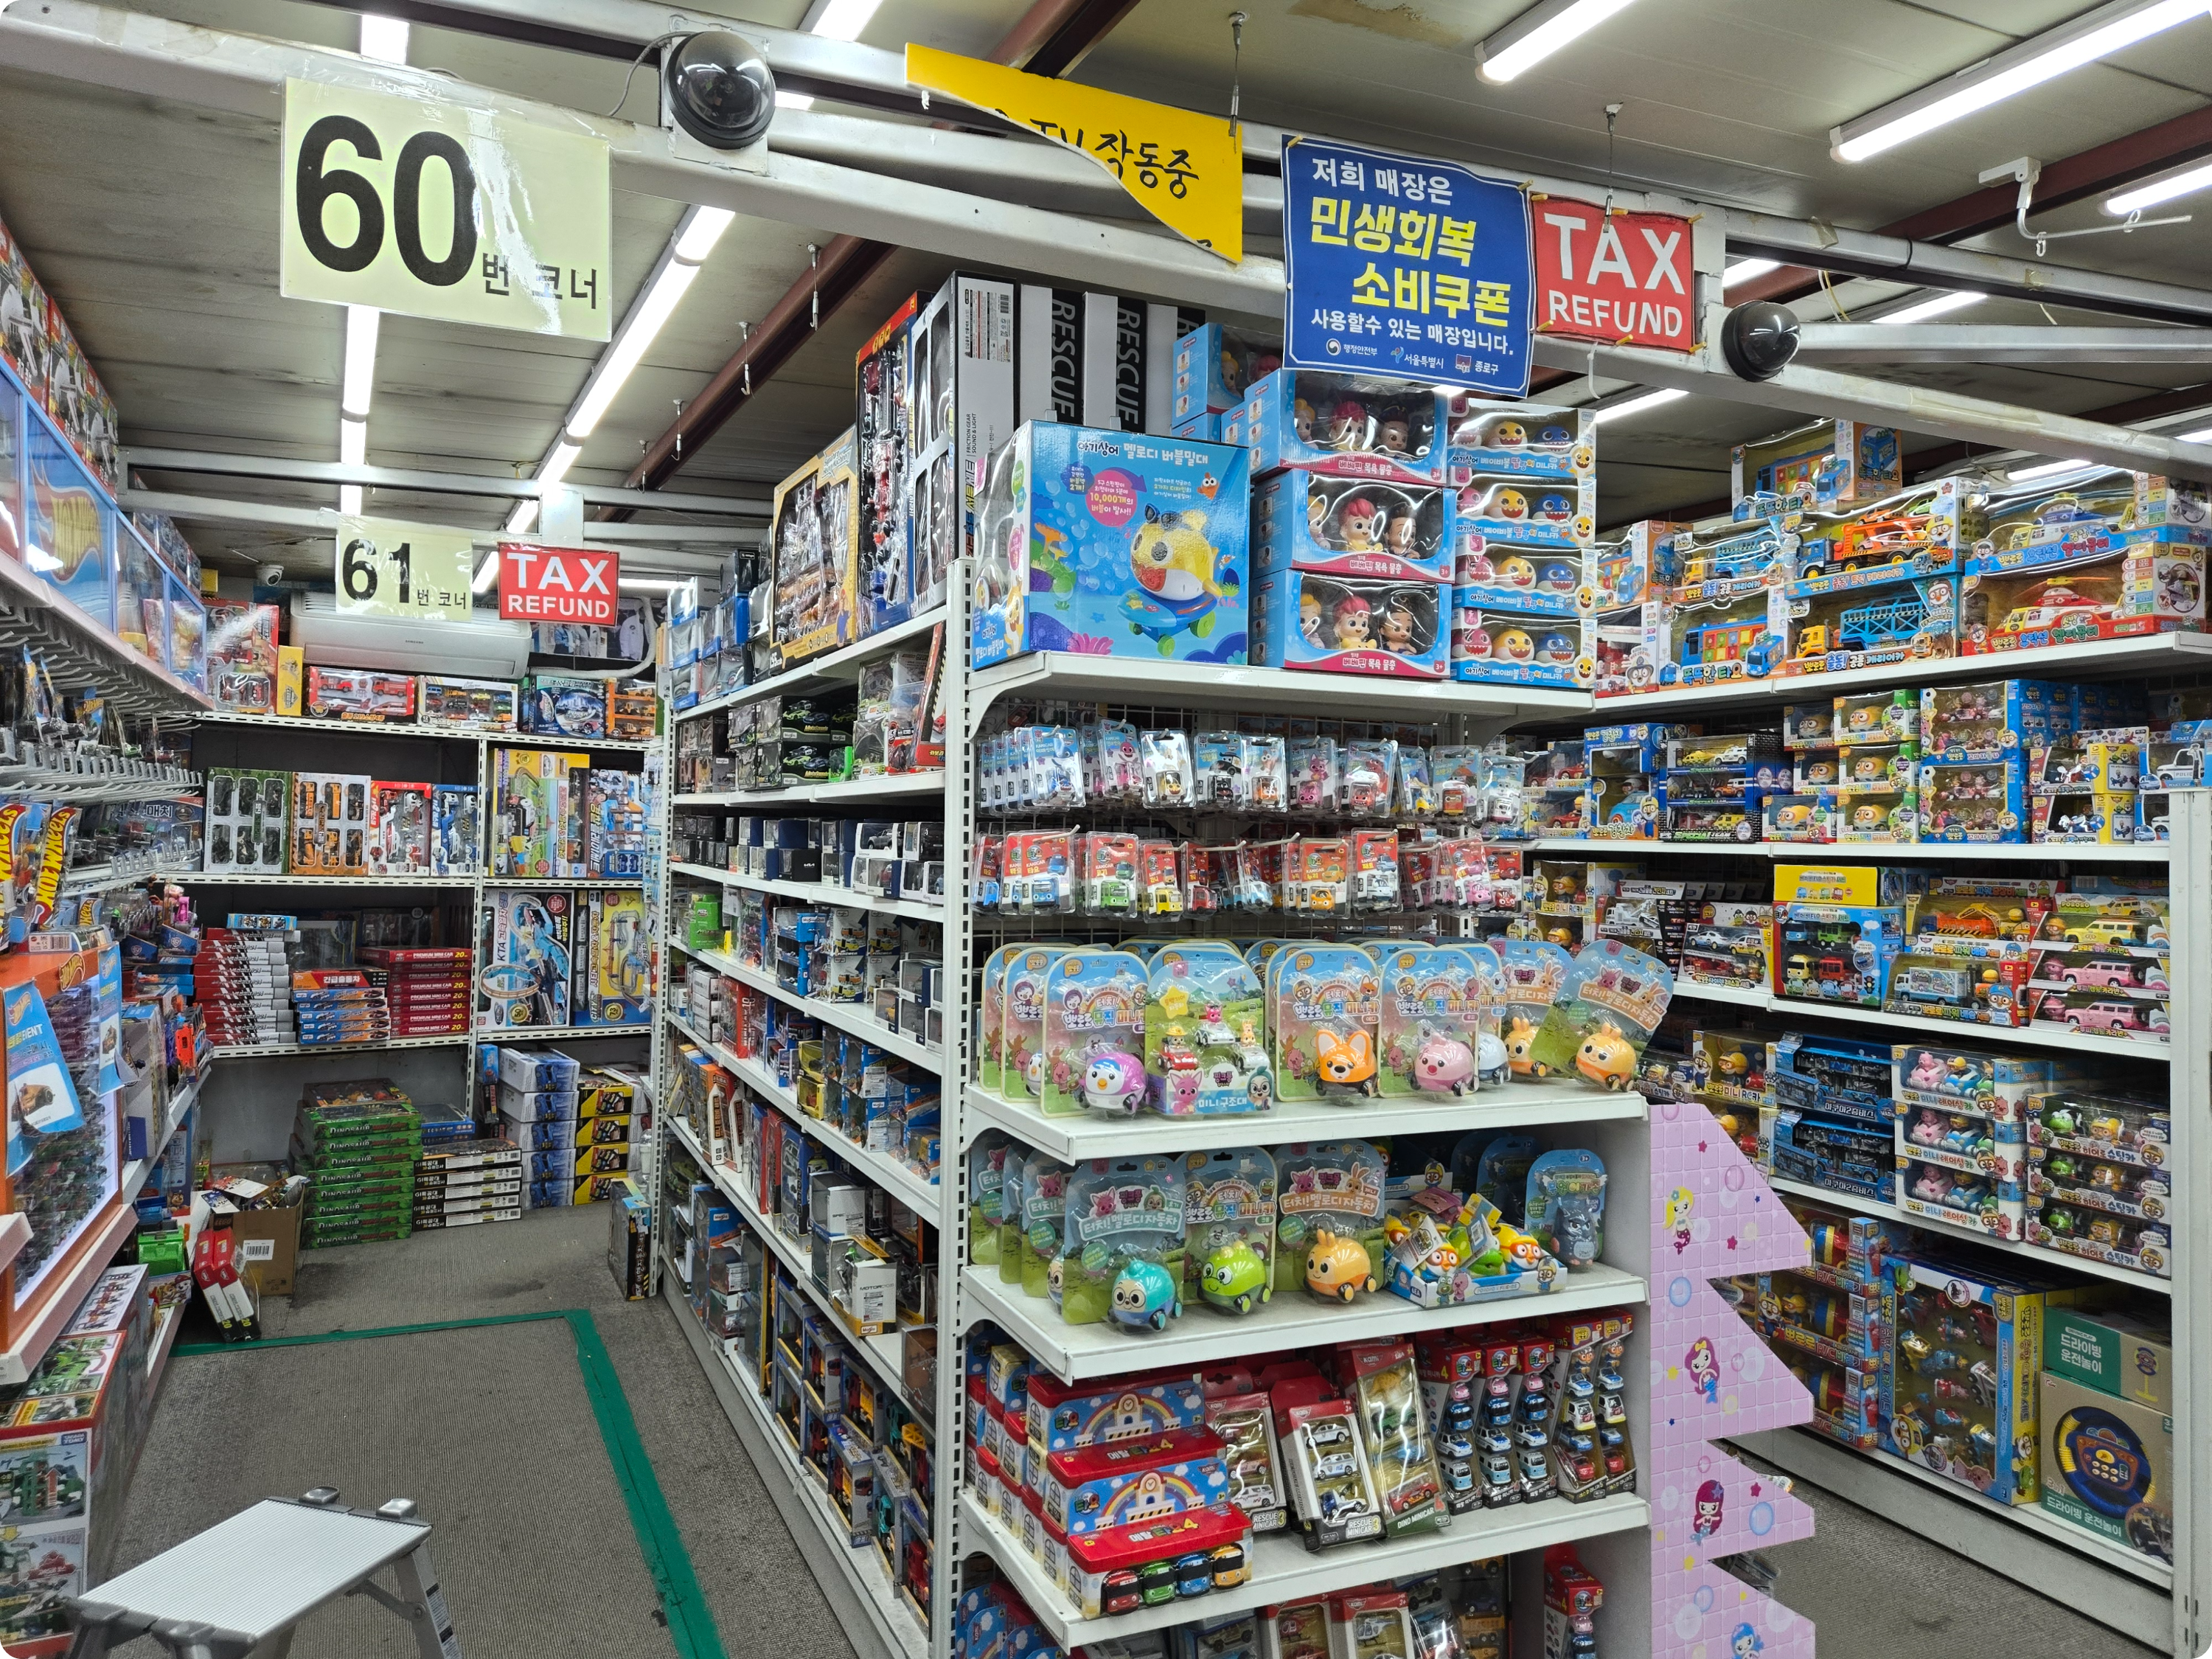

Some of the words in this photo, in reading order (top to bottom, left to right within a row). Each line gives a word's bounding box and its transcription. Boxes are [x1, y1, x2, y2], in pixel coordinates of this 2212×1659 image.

[1095, 128, 1200, 200] 작동중
[1312, 156, 1366, 191] 저희
[1376, 167, 1453, 207] 매장은
[1310, 195, 1478, 267] 민생회복
[1544, 212, 1686, 295] TAX
[532, 263, 597, 310] 코너
[1352, 262, 1512, 328] 소비쿠폰
[1549, 291, 1683, 338] REFUND
[1311, 308, 1381, 336] 사용할수
[1387, 318, 1422, 342] 있는
[1427, 325, 1514, 357] 매장입니다.
[1051, 299, 1077, 422] RESCUE
[1343, 343, 1378, 358] 행정안전부
[1404, 352, 1444, 370] 서울특별시
[1474, 361, 1499, 376] 종로구
[1116, 306, 1141, 433] RESCUE
[1078, 441, 1119, 457] 아기상어
[1123, 442, 1158, 459] 멜로디
[1161, 449, 1208, 467] 버블밀대
[1452, 455, 1478, 465] 아기상어
[1481, 457, 1511, 469] 베이비볼
[1535, 461, 1557, 470] 미니카
[1364, 462, 1377, 473] 목욕
[1090, 492, 1133, 505] 10,000개의
[1789, 491, 1812, 510] 타요
[1091, 504, 1111, 513] 버블이
[1113, 504, 1132, 515] 발사!!
[1456, 525, 1482, 535] 아기상어
[1484, 526, 1513, 538] 베이비볼
[1537, 531, 1559, 539] 미니카
[1997, 552, 2024, 567] 뽀로로
[2027, 545, 2059, 563] 후릭션
[507, 552, 611, 595] TAX
[1374, 561, 1388, 572] 목욕
[1832, 575, 1850, 590] 출동!
[1851, 574, 1865, 585] 트럭
[438, 591, 467, 610] 코너
[507, 594, 610, 619] REFUND
[2062, 613, 2079, 627] 소방
[1992, 635, 2017, 651] 뽀로로
[2019, 630, 2048, 648] 후릭션
[2051, 625, 2098, 644] 헬리콥터
[1368, 658, 1381, 669] 목욕
[1804, 660, 1825, 672] 뽀로로
[1826, 650, 1849, 672] 출동!
[1849, 654, 1865, 668] 공룡
[1464, 667, 1490, 678] 아기상어
[1492, 668, 1520, 681] 베이비볼
[1543, 672, 1562, 681] 미니카
[1682, 665, 1717, 684] 똑똑한
[1717, 662, 1743, 680] 타요
[1600, 727, 1623, 742] 경찰차
[1607, 822, 1635, 839] 경찰차
[1027, 866, 1040, 874] 타요
[1955, 885, 1975, 894] 뽀로로
[1975, 886, 1993, 896] 파워
[2061, 901, 2090, 909] PORORO
[1933, 944, 1954, 954] 뽀로로
[1954, 945, 1971, 955] 파워
[1971, 946, 1987, 957] 배송
[1987, 948, 2000, 959] 세트
[323, 975, 361, 984] 긴급출동차
[1095, 995, 1120, 1009] 터치!
[1324, 989, 1349, 1000] 터치!
[1428, 989, 1453, 1000] 터치!
[514, 1009, 521, 1017] 50
[609, 1007, 616, 1016] 73
[1295, 1003, 1323, 1019] 뽀로로
[1323, 1001, 1344, 1018] 뮤직
[1346, 1001, 1380, 1015] 미니카
[1397, 1000, 1425, 1015] 뽀로로
[1425, 1000, 1446, 1016] 뮤직
[1447, 999, 1480, 1013] 미니카
[1921, 1004, 1942, 1016] 뽀로로
[1942, 1006, 1959, 1018] 파워
[1959, 1009, 1977, 1020] 배송
[1977, 1012, 1990, 1022] 세트
[1198, 1098, 1220, 1108] 미니
[1220, 1096, 1248, 1108] 구조대
[1724, 1086, 1741, 1098] 미니
[1742, 1088, 1761, 1102] RC카
[2057, 1138, 2081, 1153] 뽀로로
[2081, 1145, 2106, 1159] 히어로
[2107, 1149, 2136, 1164] 슈팅카
[1119, 1189, 1142, 1204] 핑크퐁
[1217, 1187, 1244, 1201] 터치!
[2059, 1189, 2081, 1204] 뽀로로
[2082, 1197, 2107, 1211] 히어로
[2107, 1201, 2137, 1216] 슈팅카
[1186, 1207, 1213, 1222] 뽀로로
[1214, 1203, 1237, 1217] 뮤직
[1239, 1202, 1276, 1216] 미니카
[1925, 1205, 1941, 1217] 미니
[2056, 1239, 2079, 1253] 뽀로로
[2080, 1248, 2105, 1262] 히어로
[2106, 1251, 2136, 1267] 슈팅카
[1785, 1328, 1816, 1351] 뽀로로
[1817, 1343, 1835, 1360] R/C
[2061, 1332, 2102, 1359] 드라이빙
[2061, 1348, 2102, 1375] 운전놀이
[1440, 1366, 1448, 1379] 4
[1074, 1495, 1099, 1512] 타요
[1253, 1514, 1278, 1523] RESCUE
[1348, 1517, 1372, 1528] RESCUE
[1372, 1517, 1382, 1533] 3
[1397, 1516, 1413, 1529] DINO
[1411, 1506, 1435, 1526] MINICAR
[2046, 1497, 2082, 1520] 드라이빙
[2084, 1506, 2122, 1537] 운전놀이
[1347, 1523, 1372, 1536] MINICAR
